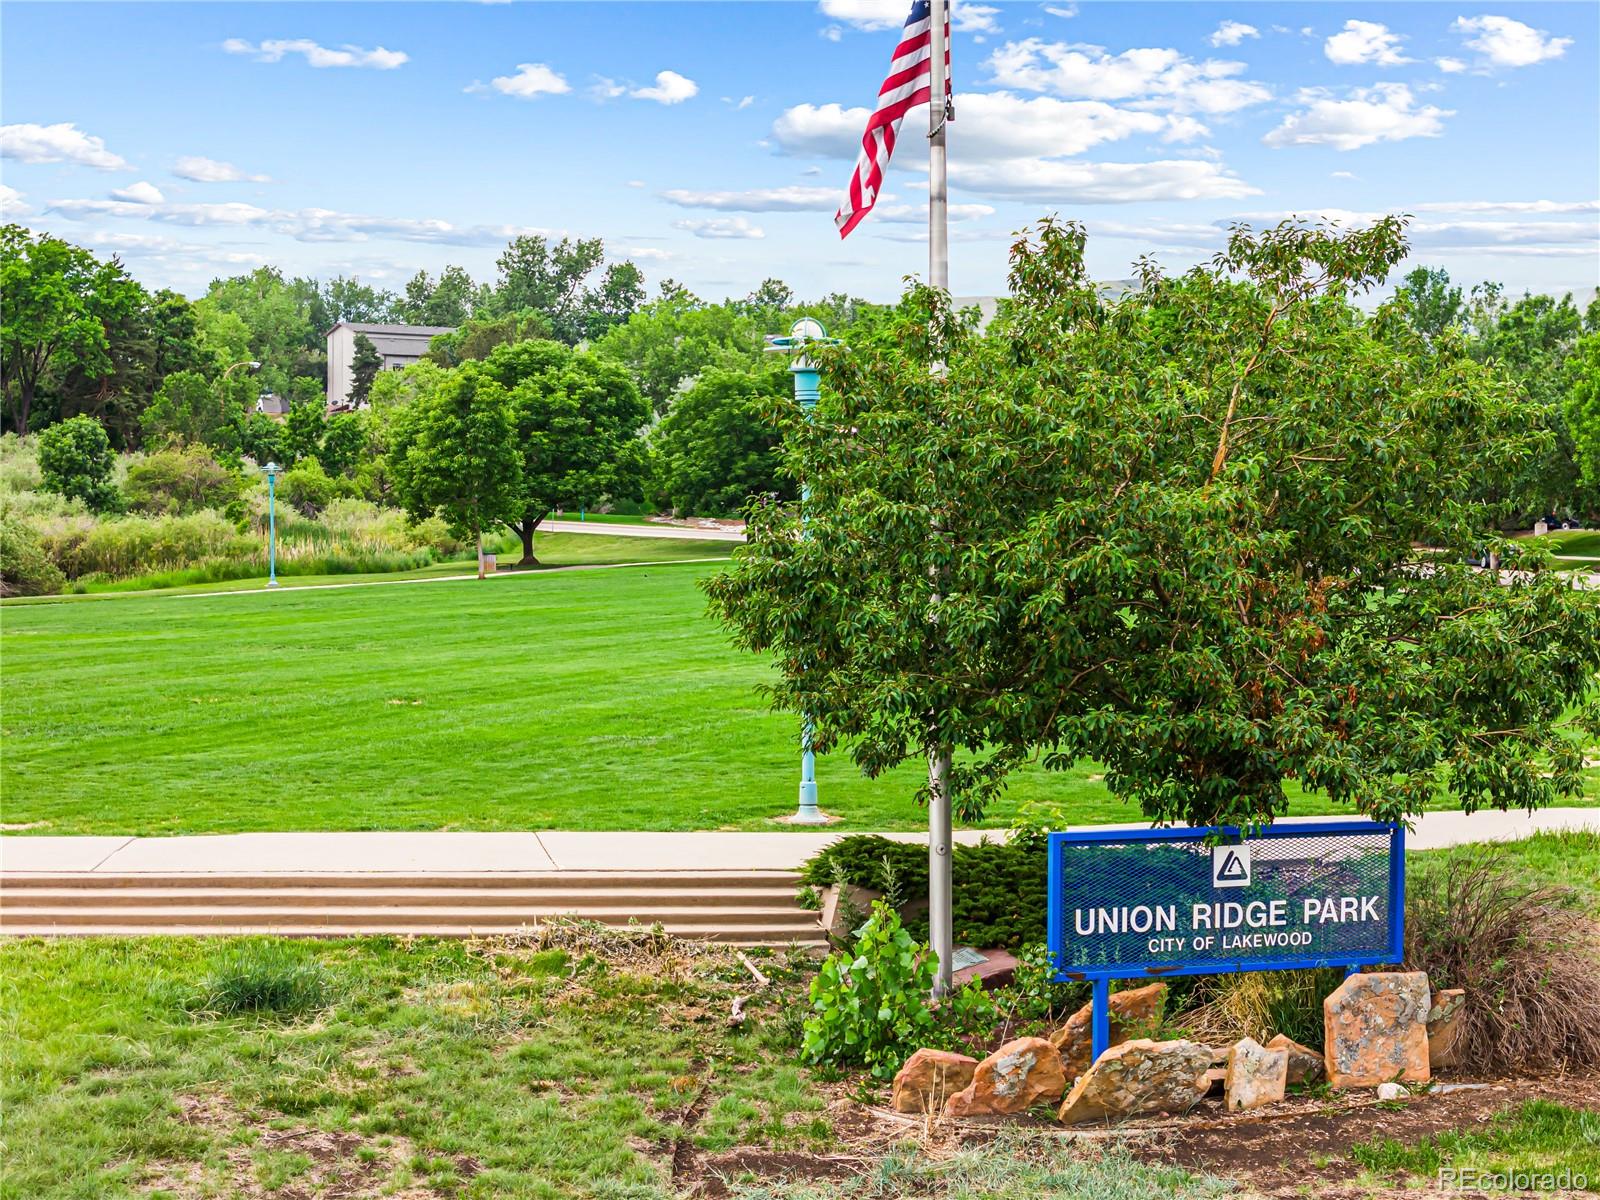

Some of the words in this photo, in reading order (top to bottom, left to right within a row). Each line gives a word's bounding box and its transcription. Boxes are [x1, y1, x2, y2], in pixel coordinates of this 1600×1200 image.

[1075, 905, 1176, 935] UNION
[1193, 900, 1286, 929] RIDGE
[1304, 895, 1380, 924] PARK
[1149, 937, 1185, 953] CITY
[1193, 936, 1214, 950] OF
[1223, 931, 1312, 949] LAKEWOOD
